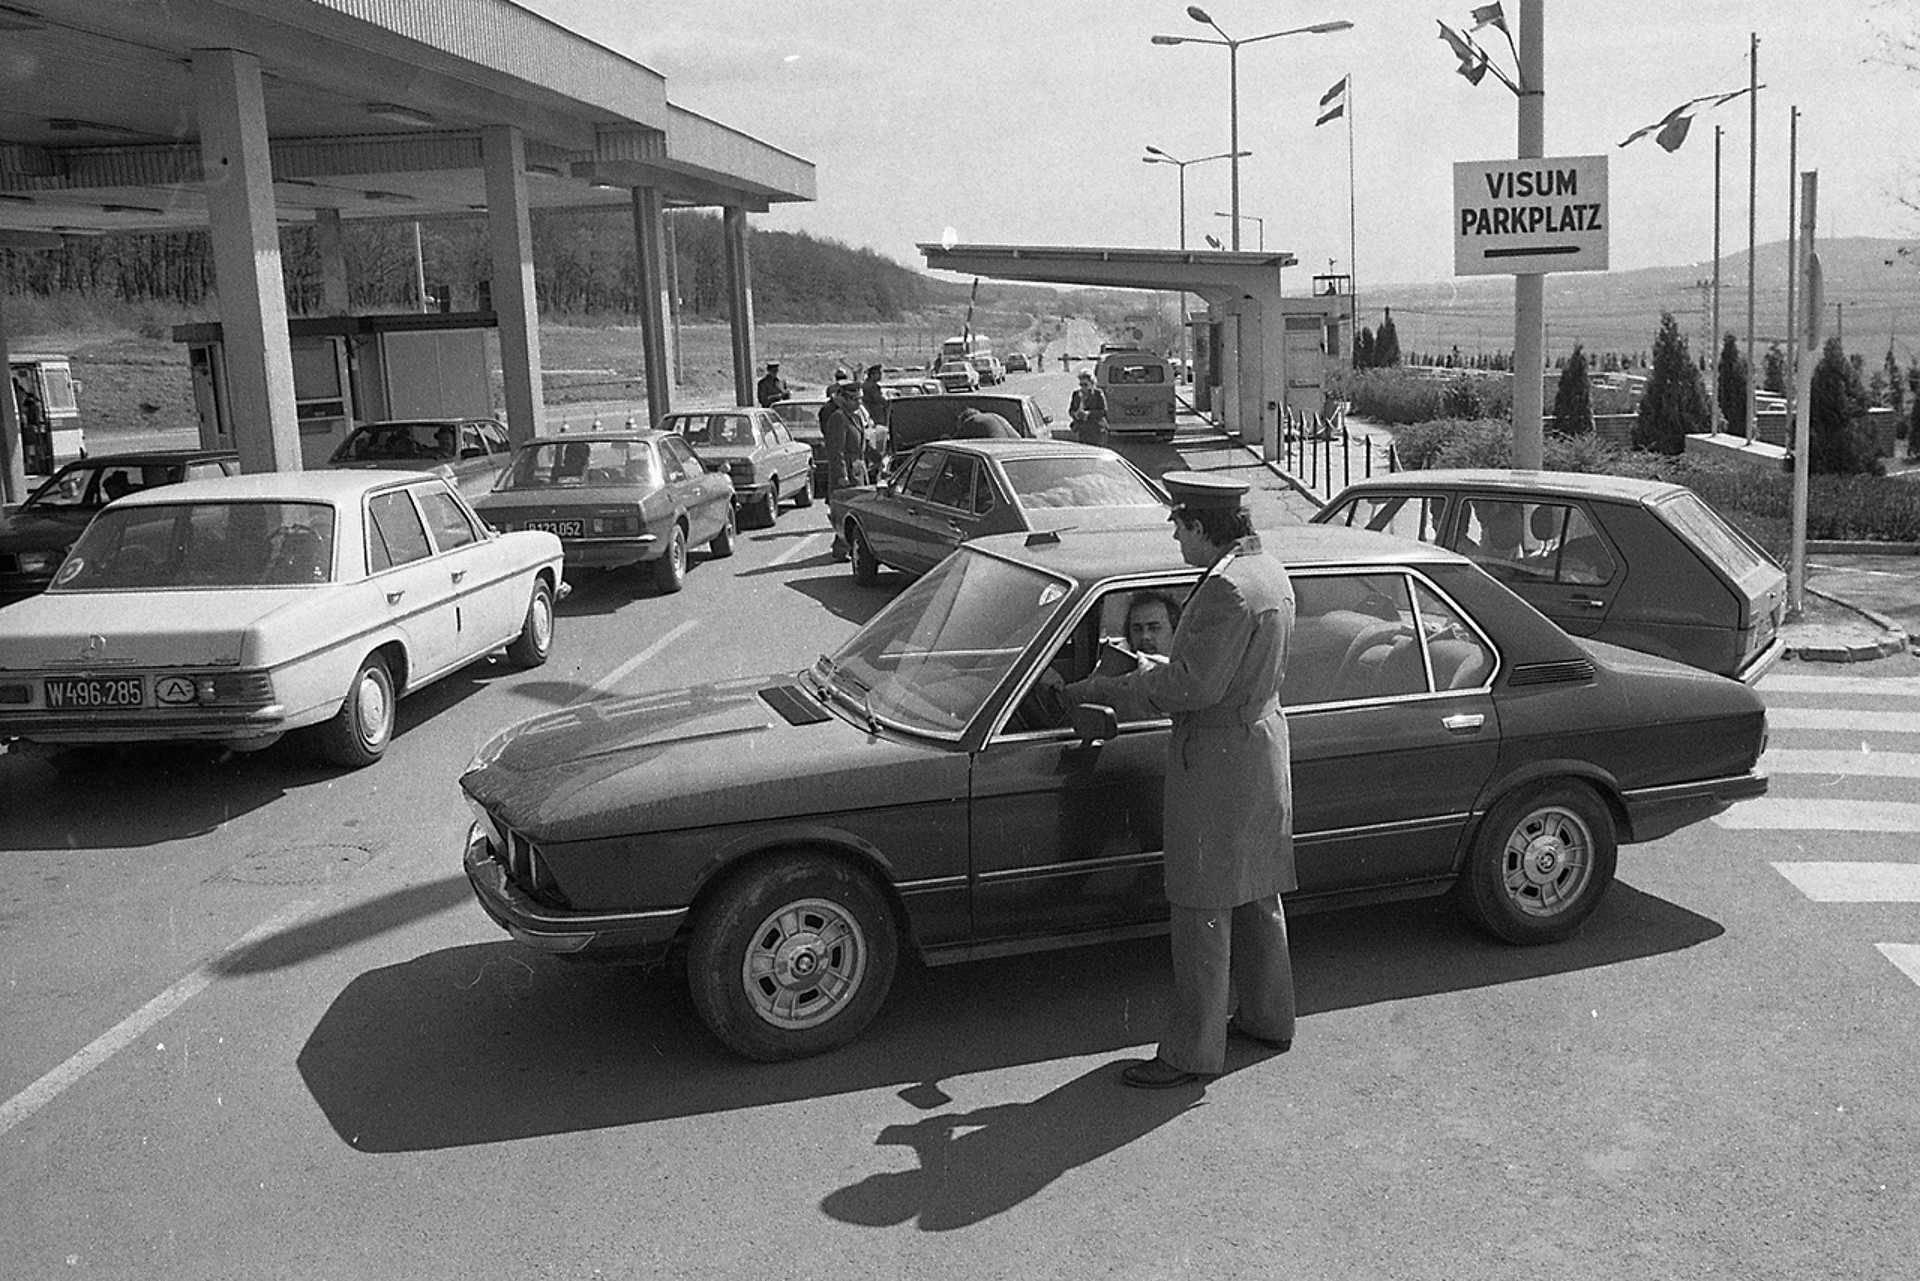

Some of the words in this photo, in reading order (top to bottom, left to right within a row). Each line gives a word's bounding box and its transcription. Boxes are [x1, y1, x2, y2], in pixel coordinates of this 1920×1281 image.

[1485, 169, 1577, 199] VISUM
[1461, 203, 1602, 235] PARKPLATZ
[166, 681, 187, 697] A
